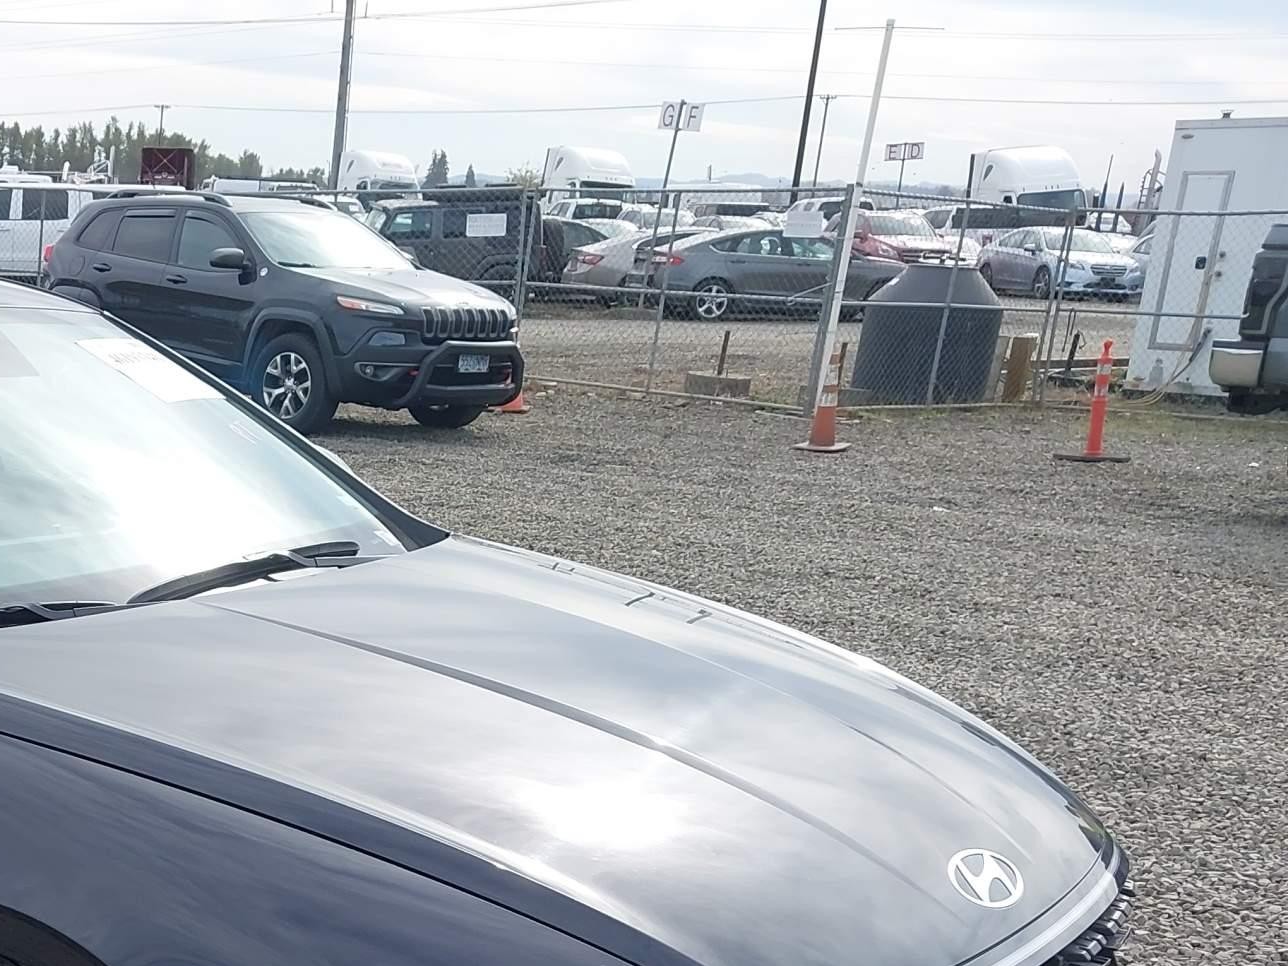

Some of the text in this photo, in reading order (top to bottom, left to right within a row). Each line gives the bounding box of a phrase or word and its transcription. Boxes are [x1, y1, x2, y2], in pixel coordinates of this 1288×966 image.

[663, 104, 675, 127] G
[687, 106, 699, 128] F
[889, 145, 898, 160] E
[911, 144, 921, 159] D
